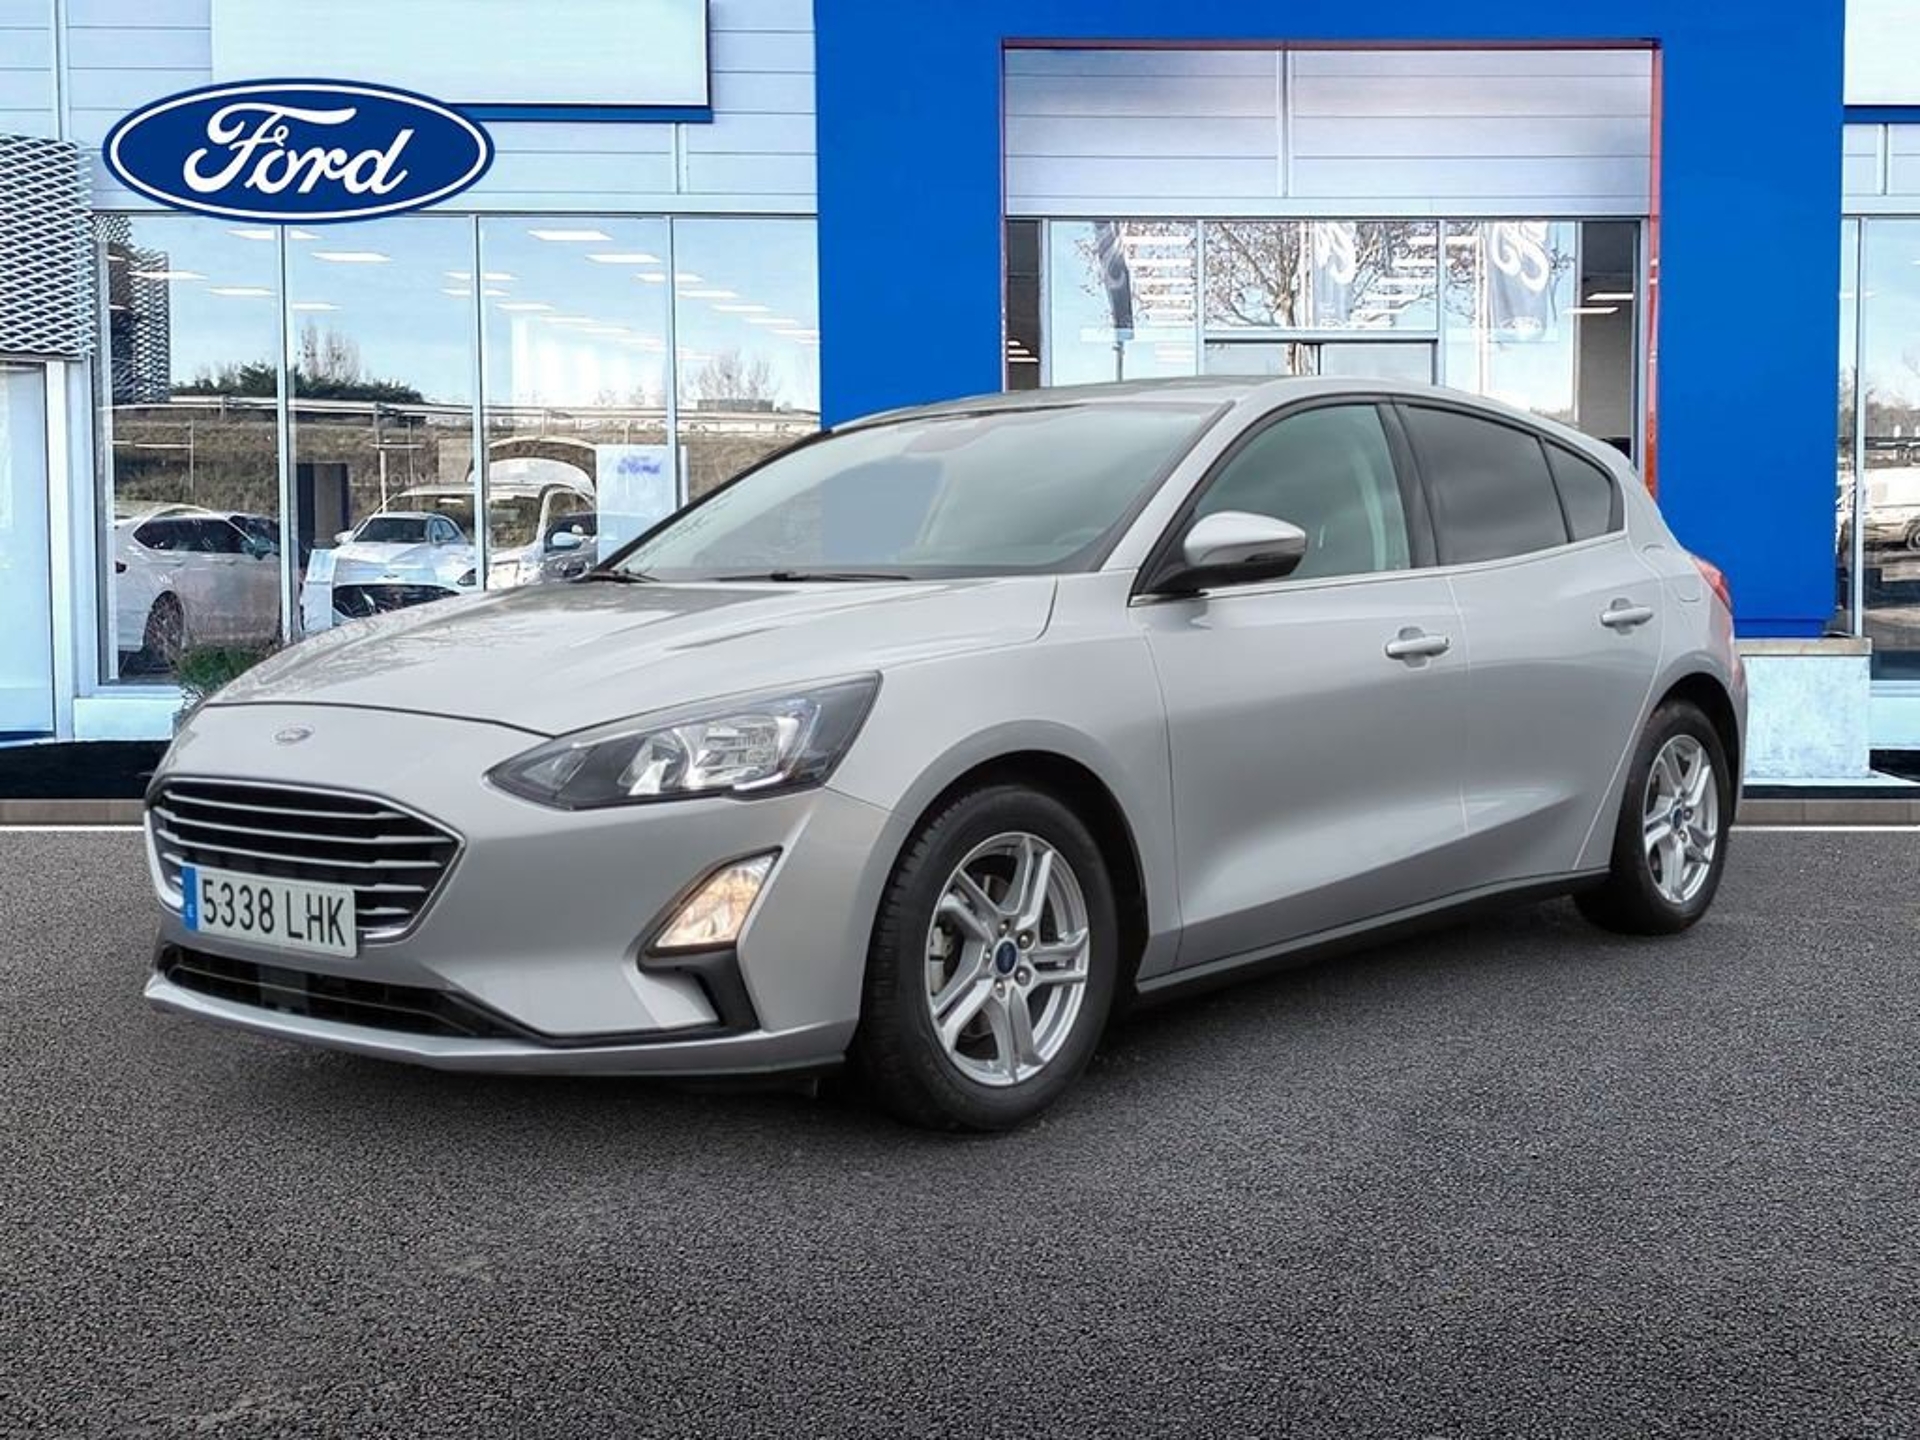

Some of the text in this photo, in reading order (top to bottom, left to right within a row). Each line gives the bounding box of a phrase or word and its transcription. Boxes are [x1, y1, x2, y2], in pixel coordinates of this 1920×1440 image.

[182, 102, 415, 194] Ford
[202, 879, 346, 947] 5338 LHK
